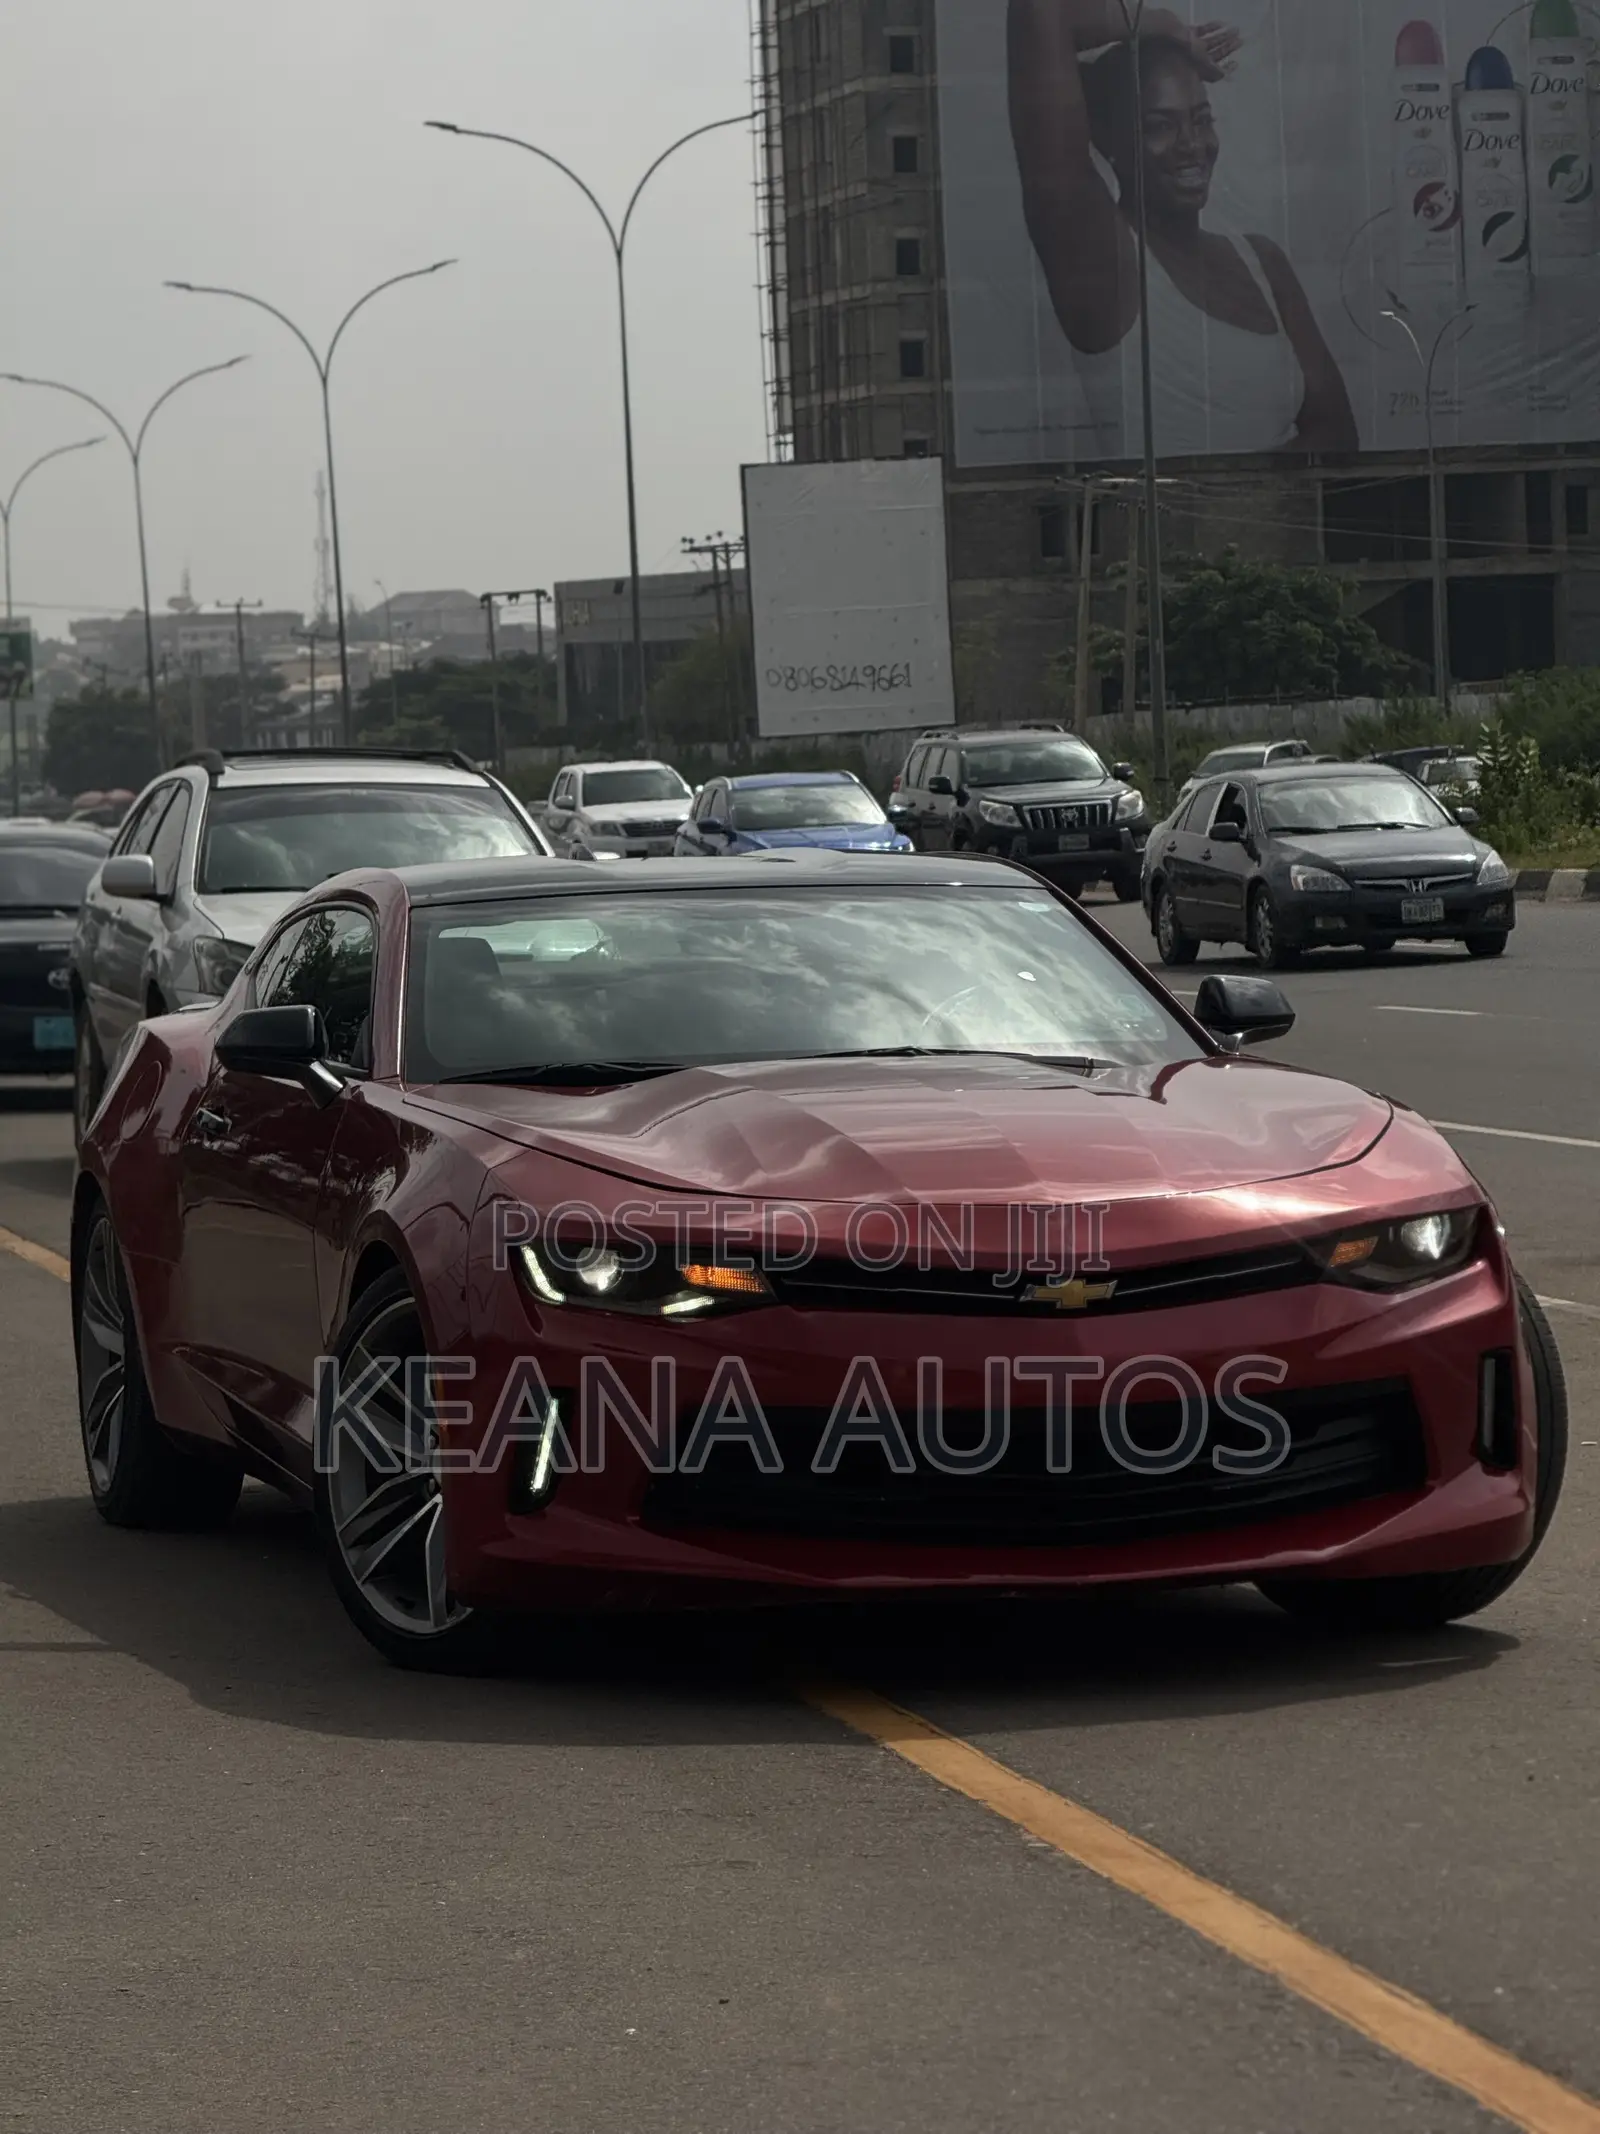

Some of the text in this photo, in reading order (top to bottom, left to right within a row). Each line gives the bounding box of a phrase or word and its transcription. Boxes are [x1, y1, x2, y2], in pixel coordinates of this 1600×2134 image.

[1529, 71, 1585, 95] Dove
[1394, 98, 1450, 122] Dove
[1463, 128, 1520, 152] Dove
